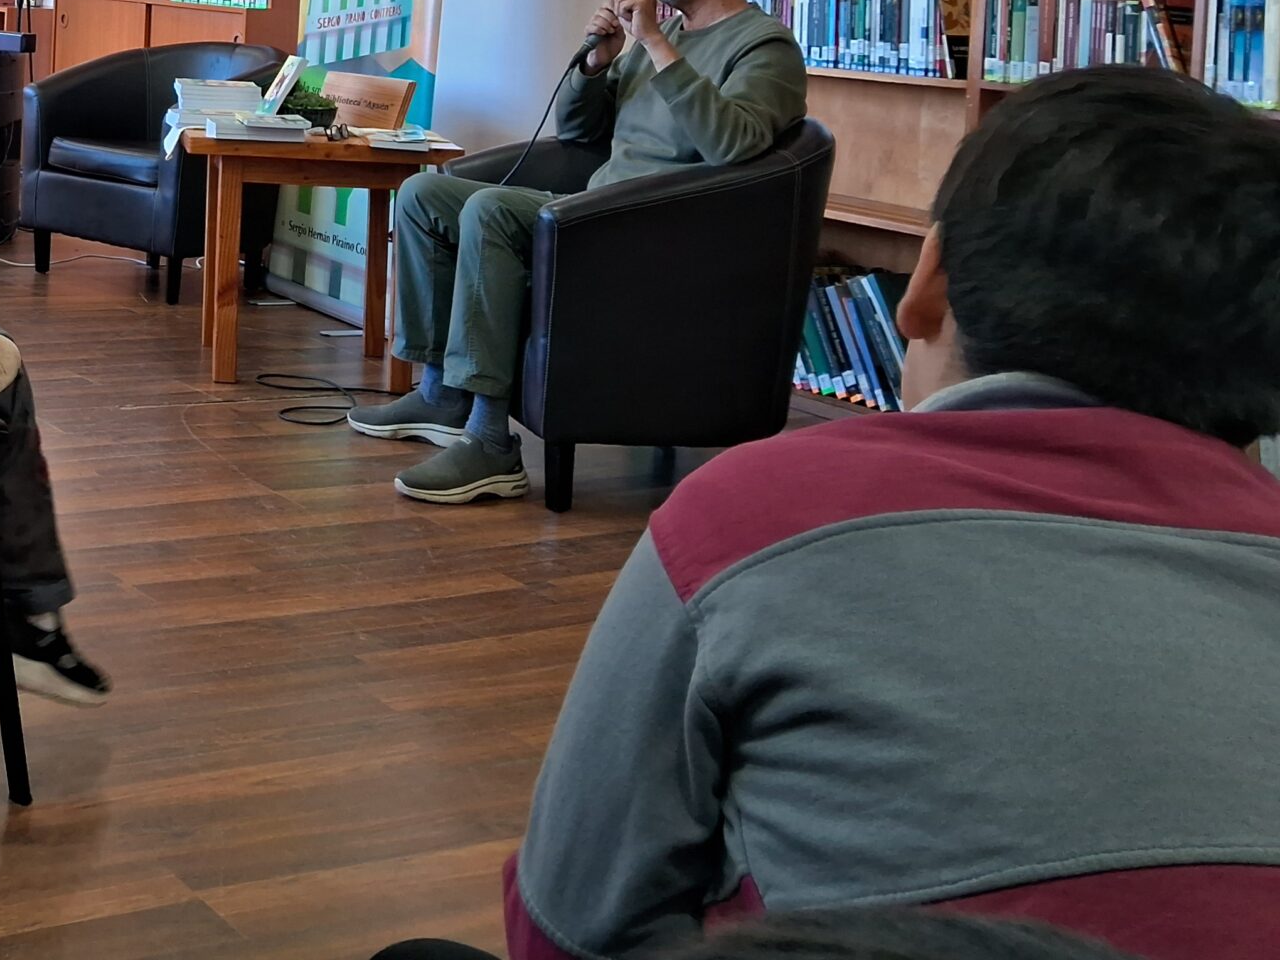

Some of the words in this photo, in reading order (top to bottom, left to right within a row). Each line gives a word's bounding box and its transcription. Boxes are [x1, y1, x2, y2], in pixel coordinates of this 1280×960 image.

[316, 15, 341, 30] SERGIO
[325, 93, 361, 107] Biblioteca
[288, 220, 307, 237] Sergio
[308, 226, 331, 243] Hernán
[332, 234, 355, 252] Piraino
